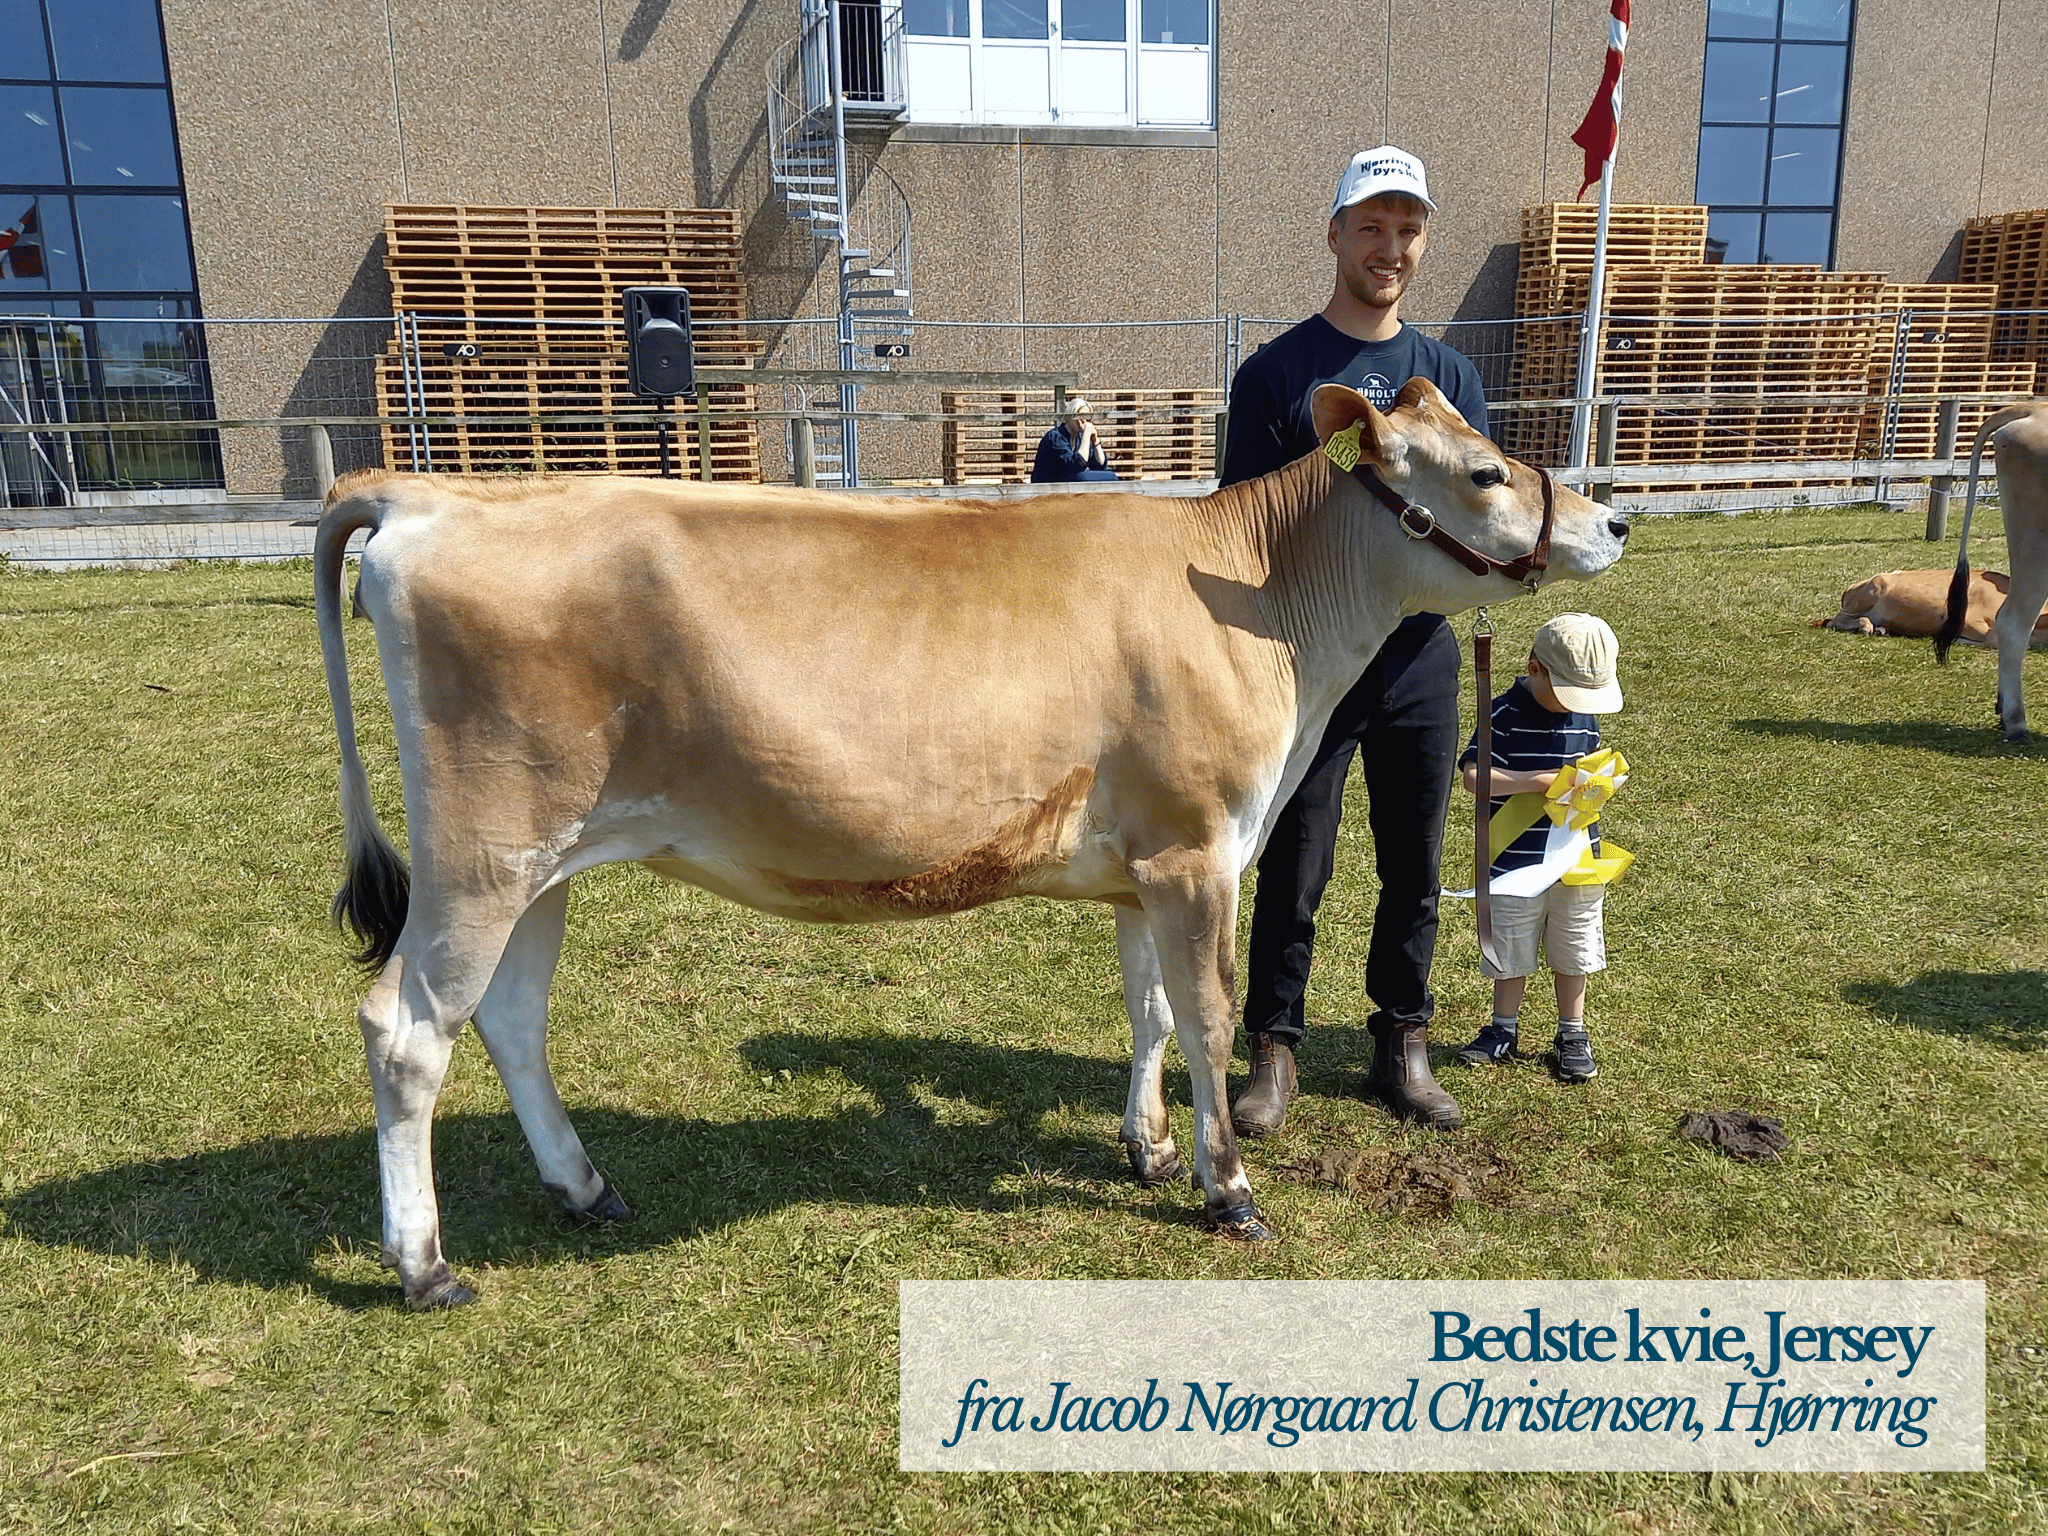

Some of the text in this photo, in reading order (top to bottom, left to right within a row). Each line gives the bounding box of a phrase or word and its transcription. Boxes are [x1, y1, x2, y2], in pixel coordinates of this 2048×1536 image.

[1615, 339, 1632, 349] AO
[1931, 333, 1946, 343] AO
[456, 344, 476, 356] AO
[886, 345, 904, 357] AO
[1326, 436, 1358, 469] 05439
